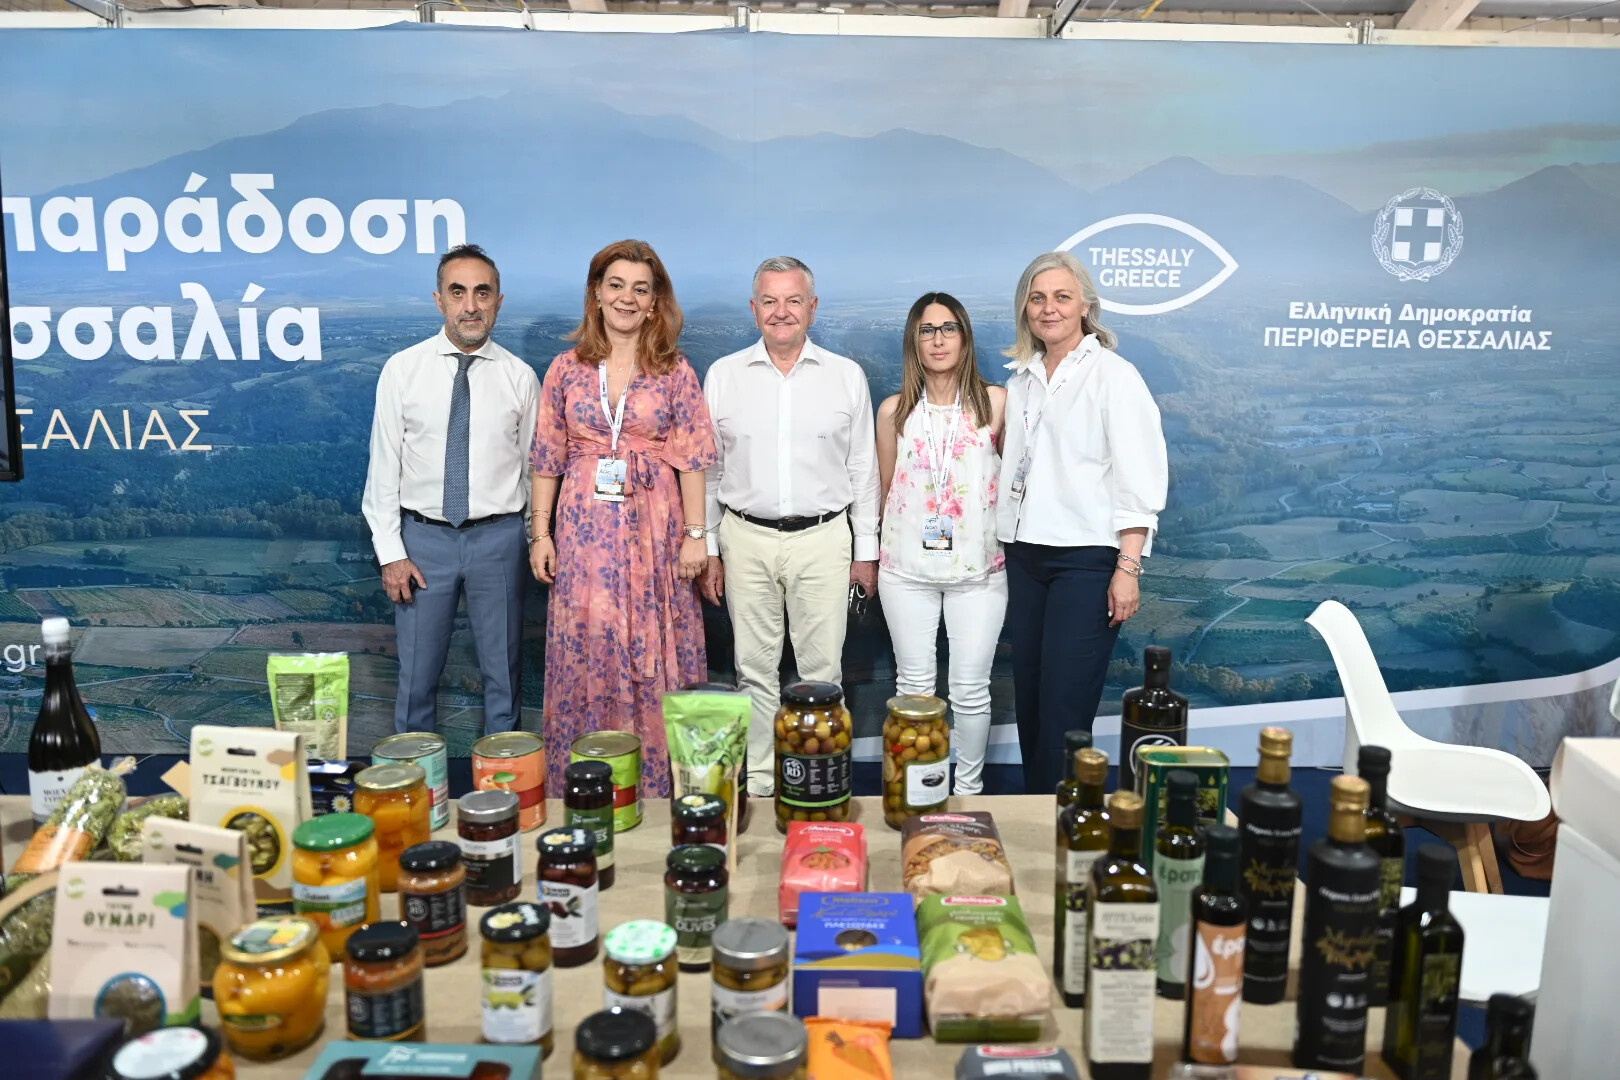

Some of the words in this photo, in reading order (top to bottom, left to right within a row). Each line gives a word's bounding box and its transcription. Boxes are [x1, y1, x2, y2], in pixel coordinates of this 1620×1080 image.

[1089, 248, 1194, 267] THESSALY
[1099, 269, 1181, 288] GREECE
[9, 282, 322, 361] σσαλία
[1289, 301, 1391, 324] Ελληνική
[1398, 303, 1532, 325] Δημοκρατία
[1264, 327, 1411, 348] ΠΕΡΙΦΕΡΕΙΑ
[1418, 329, 1552, 350] ΘΕΣΣΑΛΙΑΣ
[83, 911, 155, 929] ΘΥΜΑΡΙ
